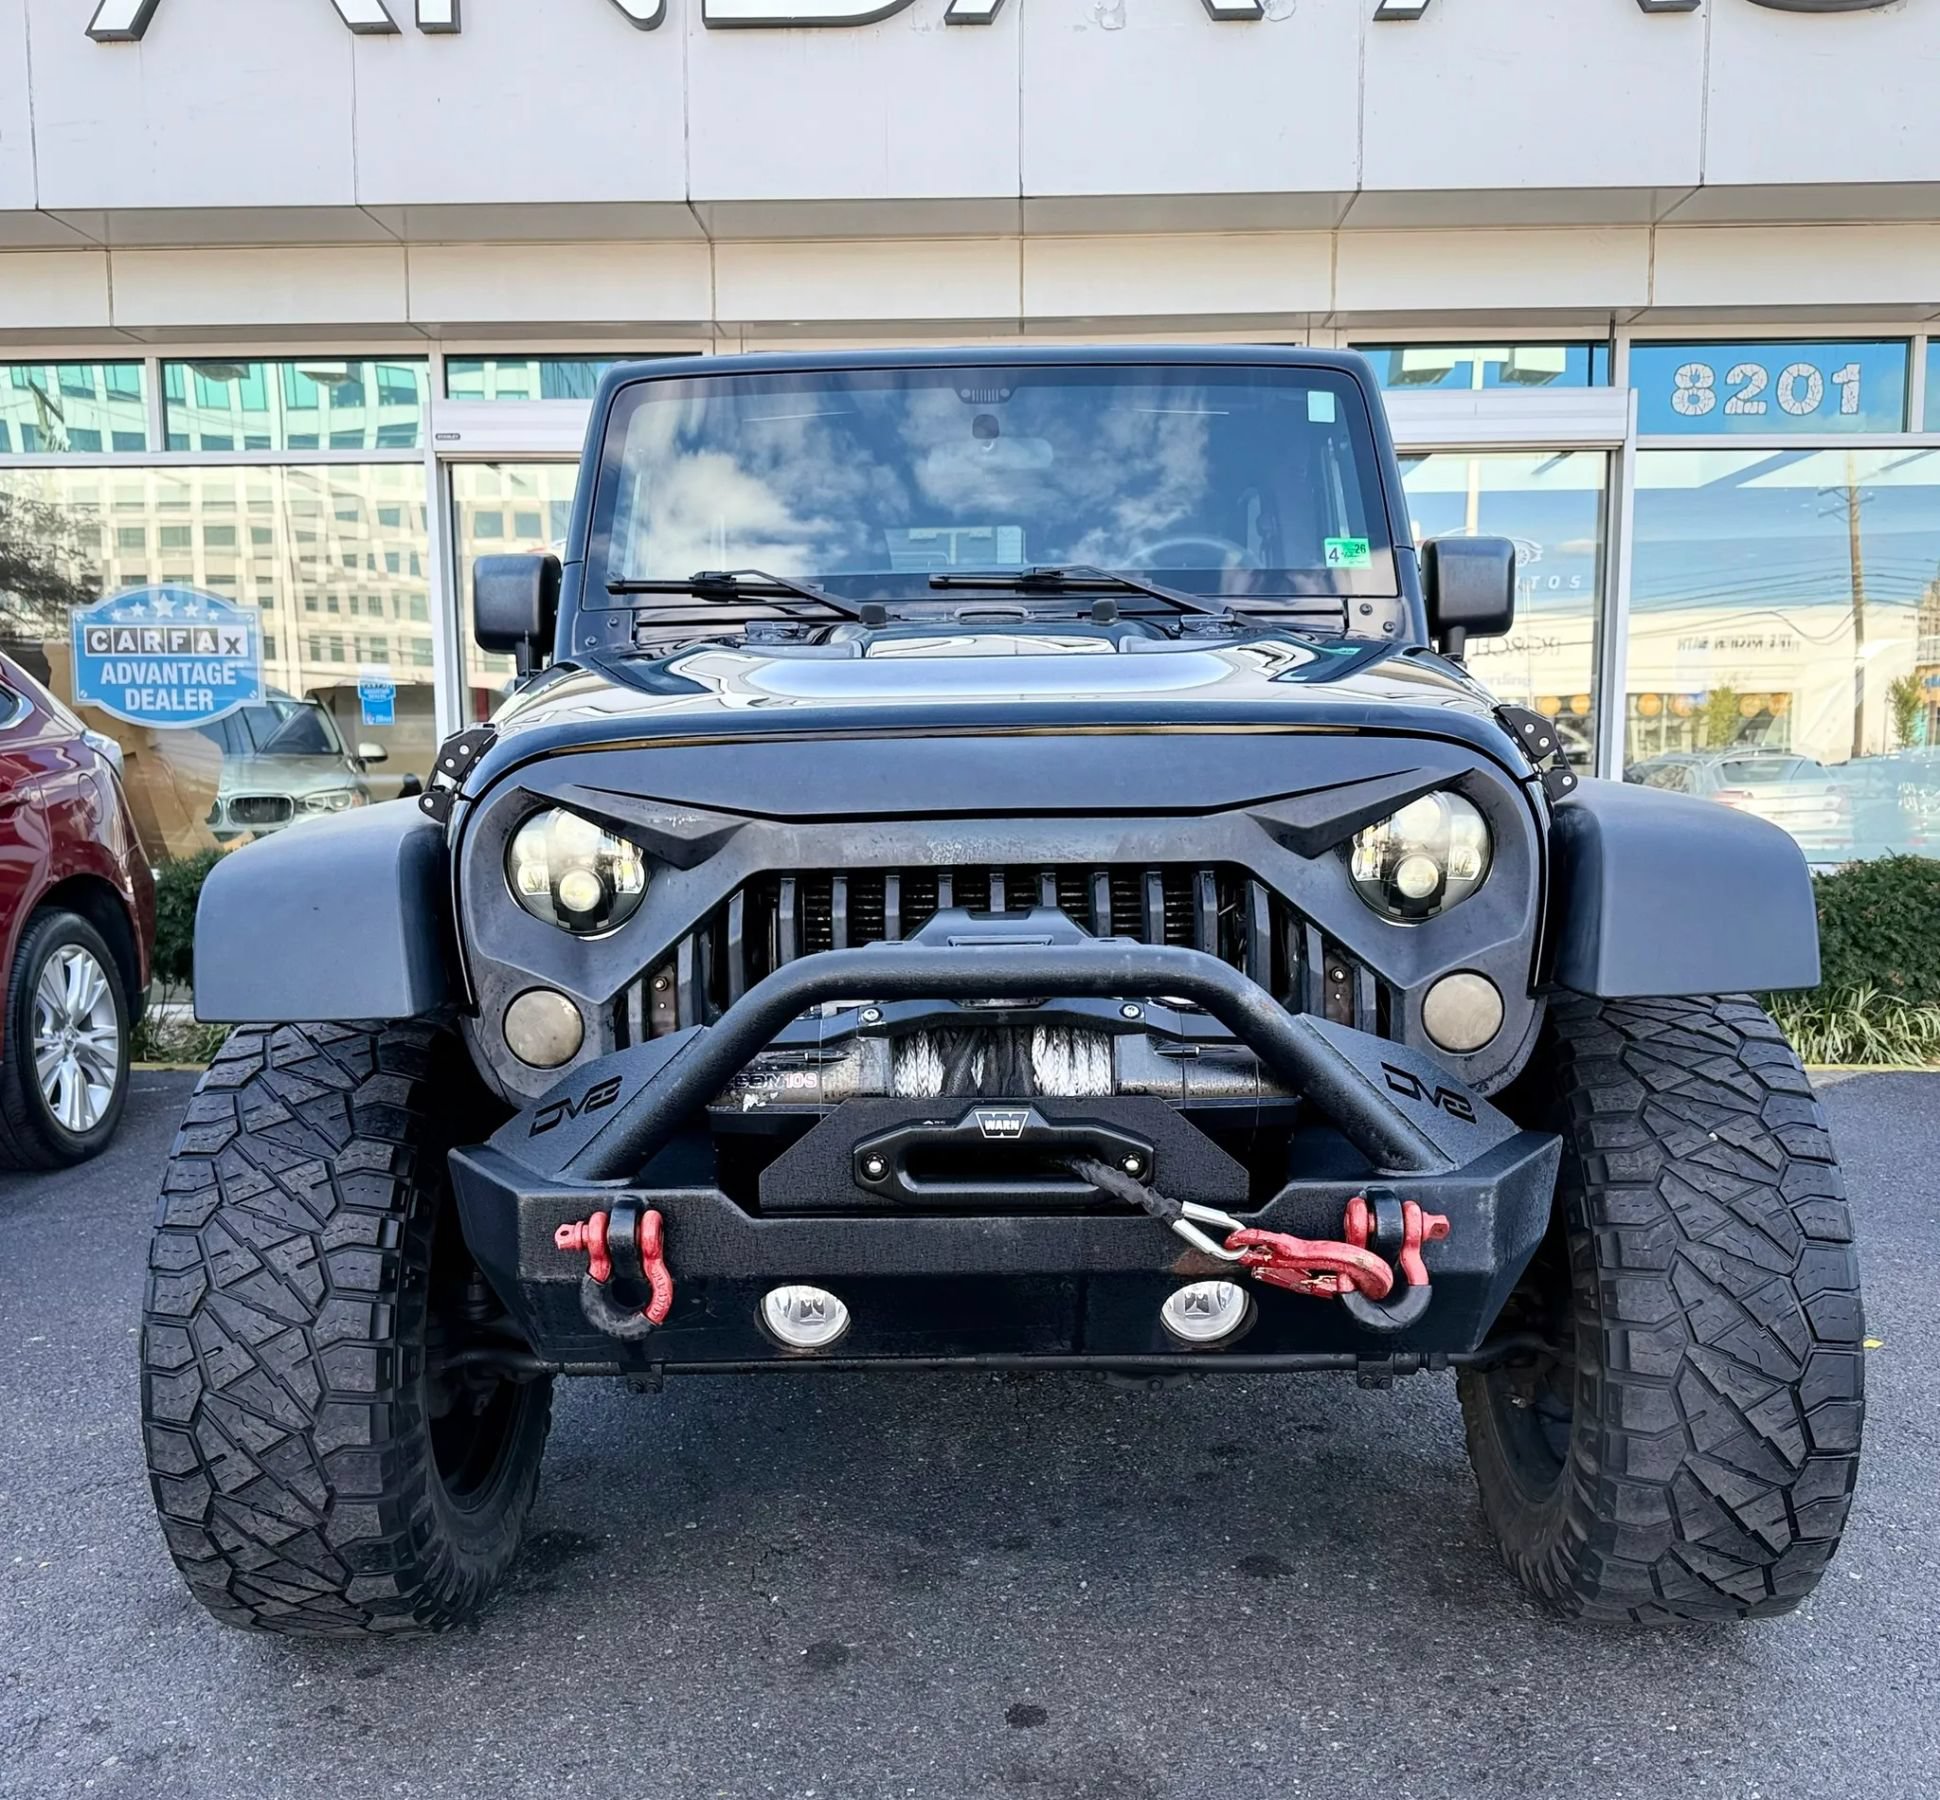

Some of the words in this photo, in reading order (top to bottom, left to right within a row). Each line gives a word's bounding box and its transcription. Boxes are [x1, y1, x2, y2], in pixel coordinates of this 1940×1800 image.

[1670, 362, 1861, 416] 8201
[1328, 547, 1340, 562] 4
[90, 630, 242, 655] CARFAX
[100, 662, 237, 685] ADVANTAGE
[125, 688, 214, 711] DEALER
[984, 1119, 1020, 1131] WARN
